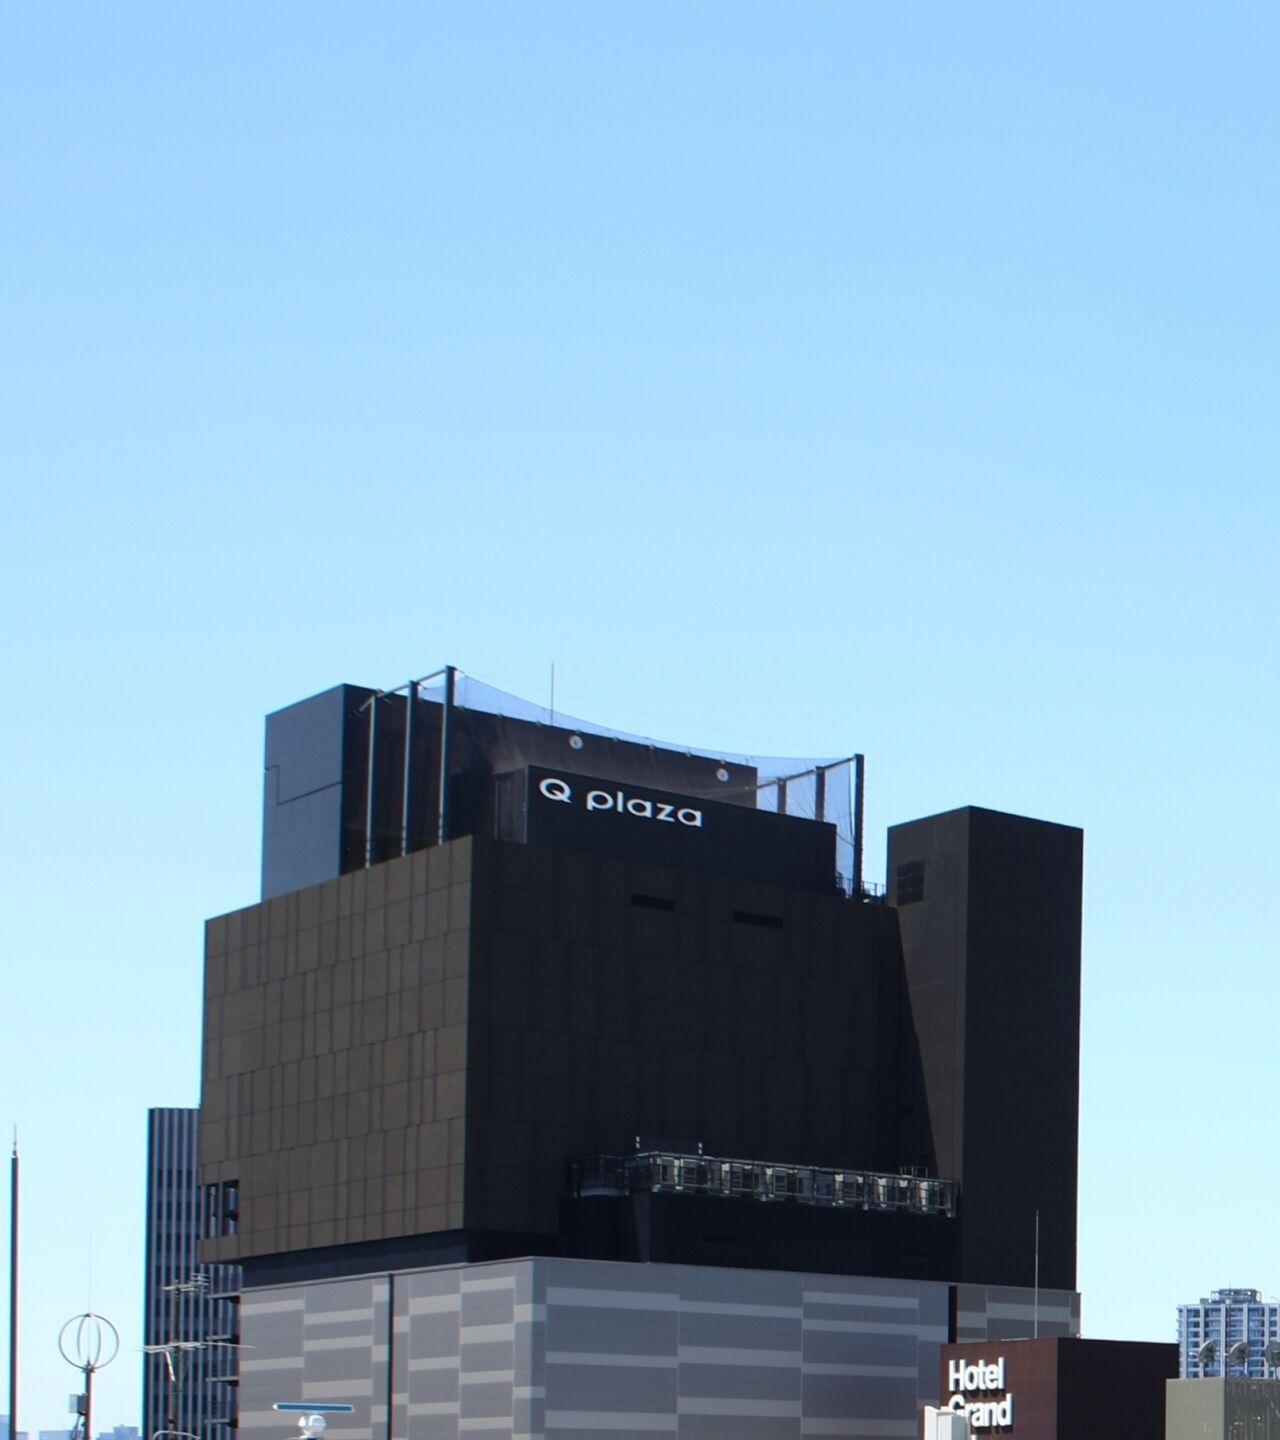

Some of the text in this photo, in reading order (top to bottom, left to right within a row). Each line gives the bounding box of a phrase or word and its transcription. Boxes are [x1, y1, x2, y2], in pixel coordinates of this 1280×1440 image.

[539, 778, 703, 827] Q plaza
[948, 1357, 1005, 1391] Hotel
[948, 1393, 1013, 1427] Grand
